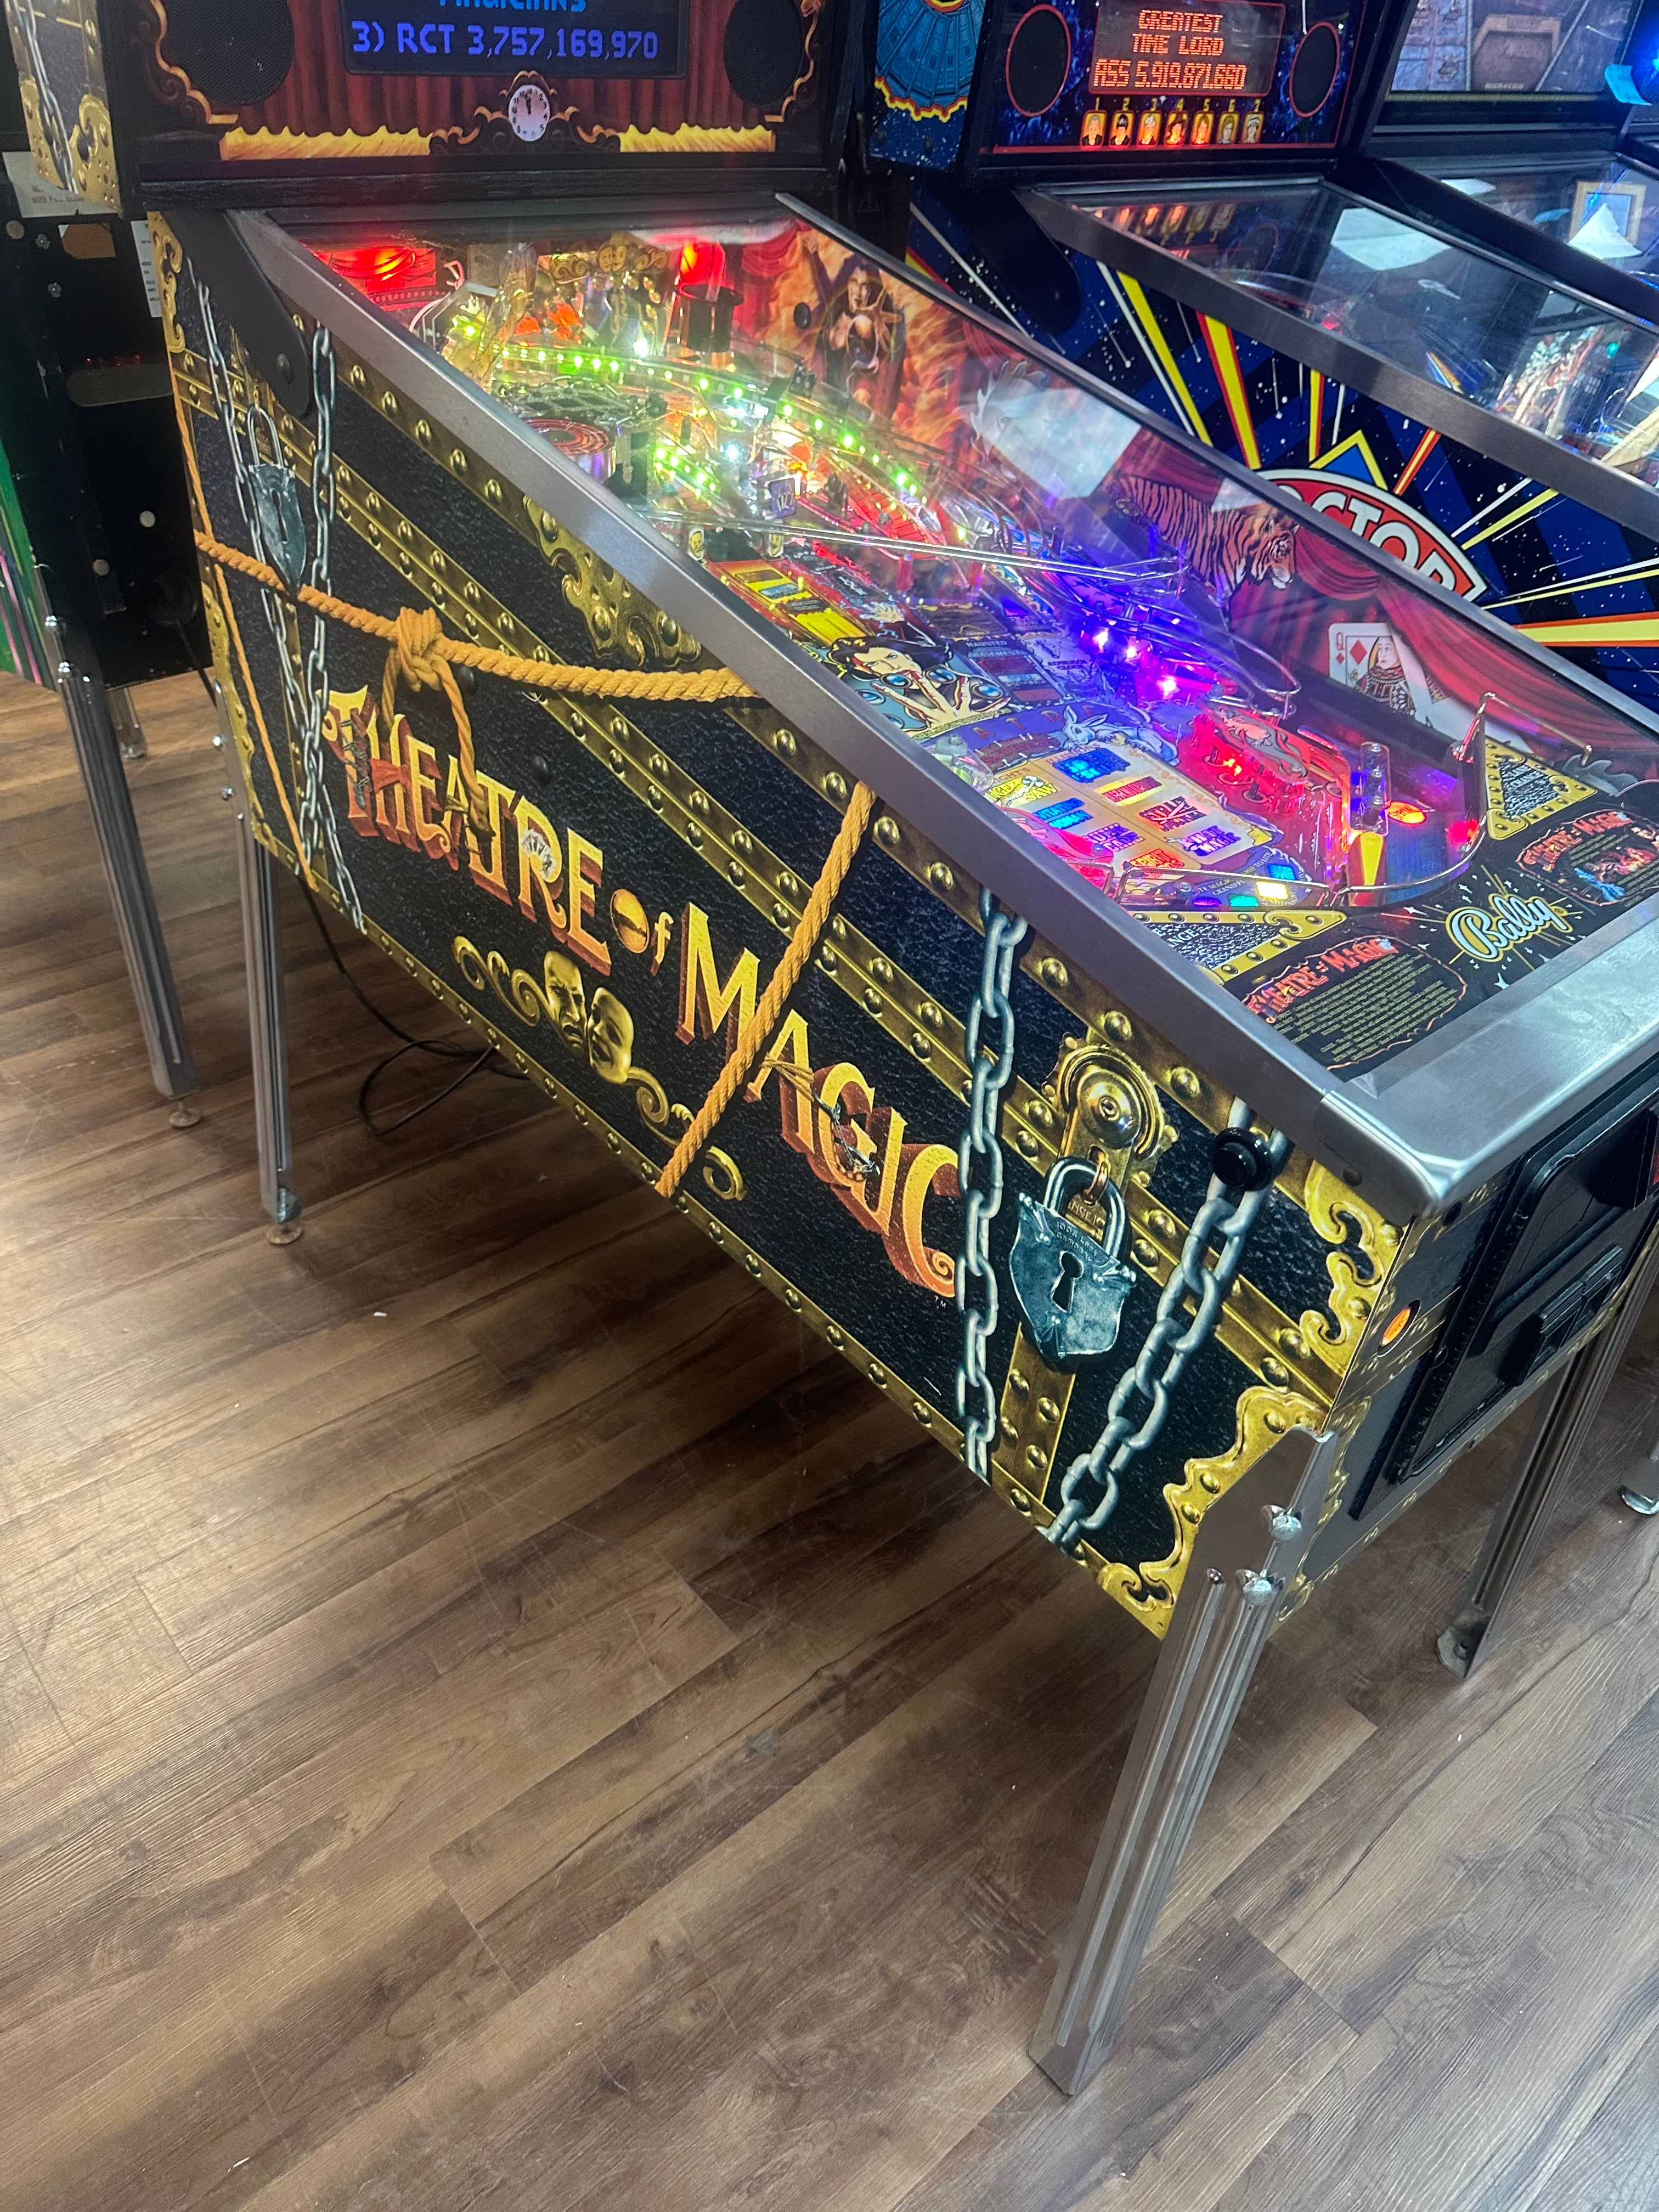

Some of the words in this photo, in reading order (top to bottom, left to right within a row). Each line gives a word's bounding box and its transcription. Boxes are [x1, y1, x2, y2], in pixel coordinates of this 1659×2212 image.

[1138, 9, 1223, 32] GREATEST
[352, 20, 385, 54] 3)
[397, 22, 455, 54] RCT
[468, 25, 658, 60] 3,757,169,970
[1132, 33, 1170, 54] TIME
[1178, 35, 1224, 56] LORD
[1093, 59, 1131, 87] ASS
[1094, 96, 1100, 110] 1
[1122, 97, 1130, 110] 2
[1150, 98, 1158, 110] 3
[1176, 98, 1184, 110] 4
[1203, 98, 1210, 110] 5
[1228, 99, 1235, 111] 6
[1254, 99, 1261, 112] 7
[1278, 485, 1457, 592] CTOR
[966, 640, 1007, 648] HAUNTED
[1336, 632, 1344, 651] Q
[1022, 783, 1058, 802] SAW
[1190, 825, 1226, 844] HAT
[1198, 832, 1242, 854] MAGIC
[1523, 830, 1583, 872] THEATRE
[1451, 896, 1567, 960] Bally
[323, 685, 611, 977] THEATRE
[675, 901, 960, 1298] MAGIC
[1246, 966, 1329, 1024] THEATRE
[1321, 937, 1400, 973] MAGIC
